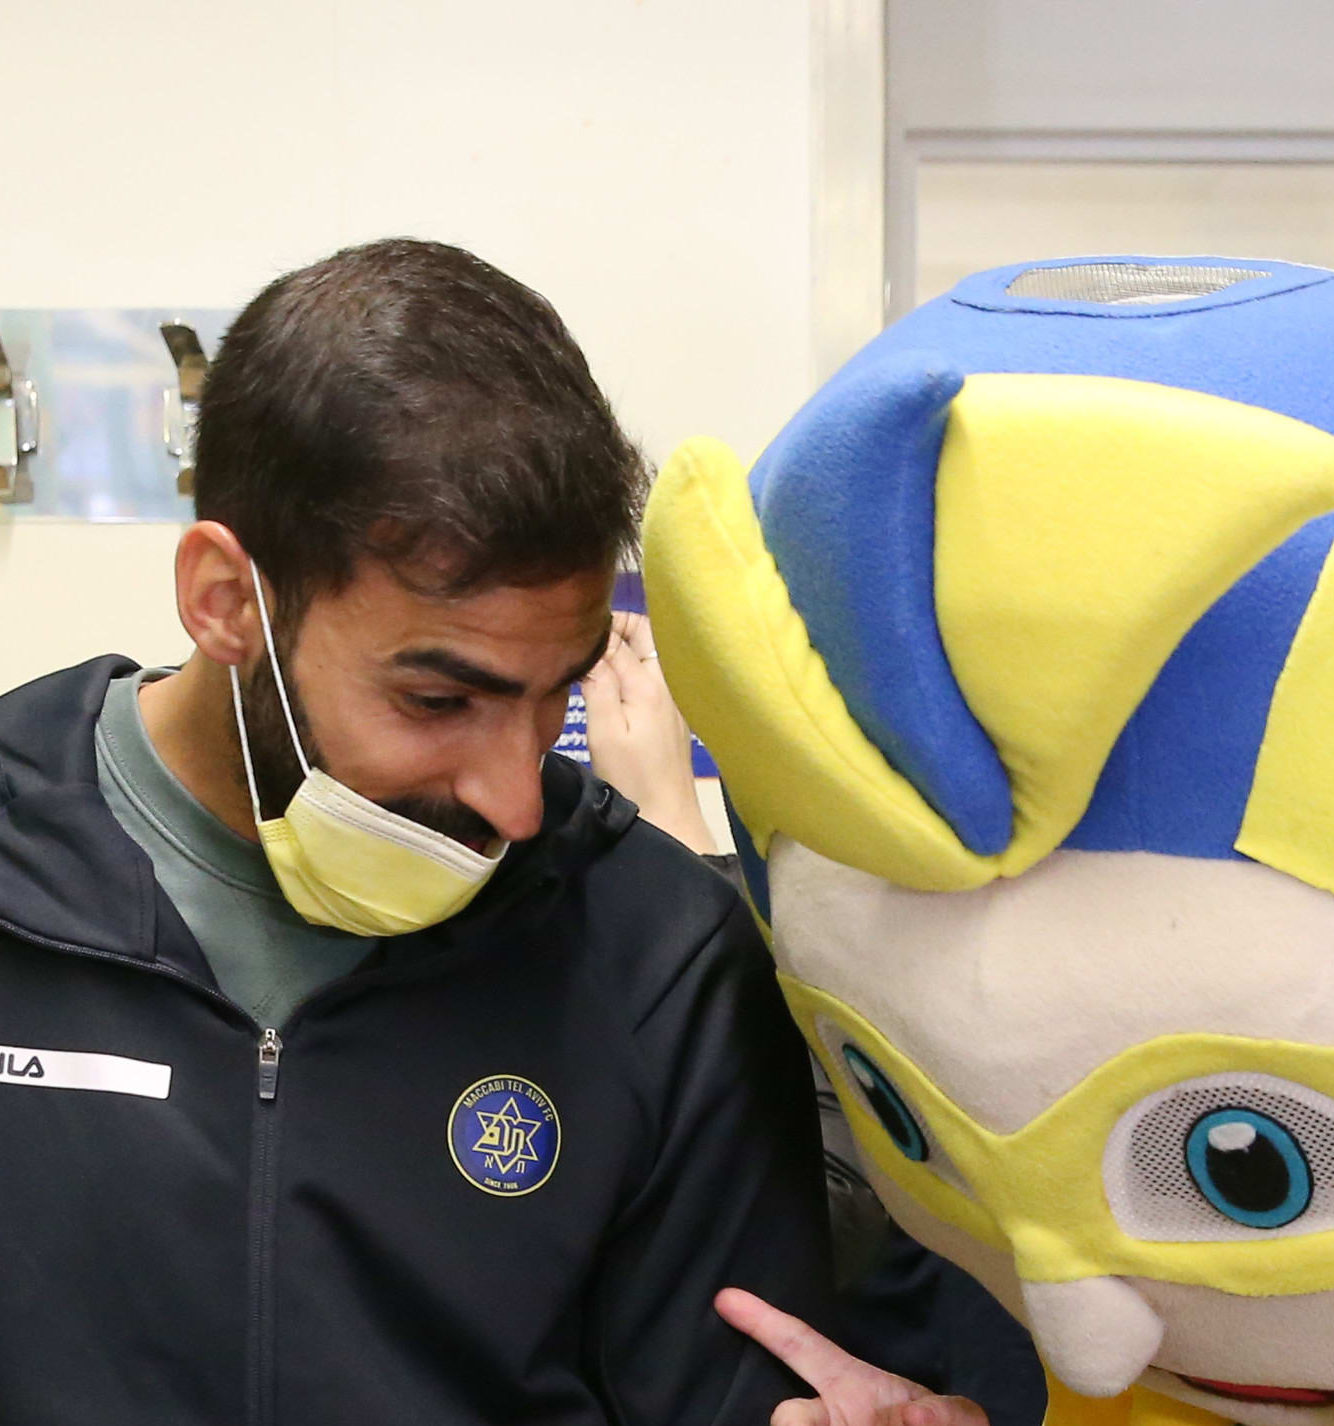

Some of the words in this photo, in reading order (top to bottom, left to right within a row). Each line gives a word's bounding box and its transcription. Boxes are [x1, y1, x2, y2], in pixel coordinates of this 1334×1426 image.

[463, 1080, 505, 1109] MACCABI
[507, 1080, 524, 1094] TEL
[525, 1088, 547, 1108] AVIV
[541, 1107, 554, 1122] FC
